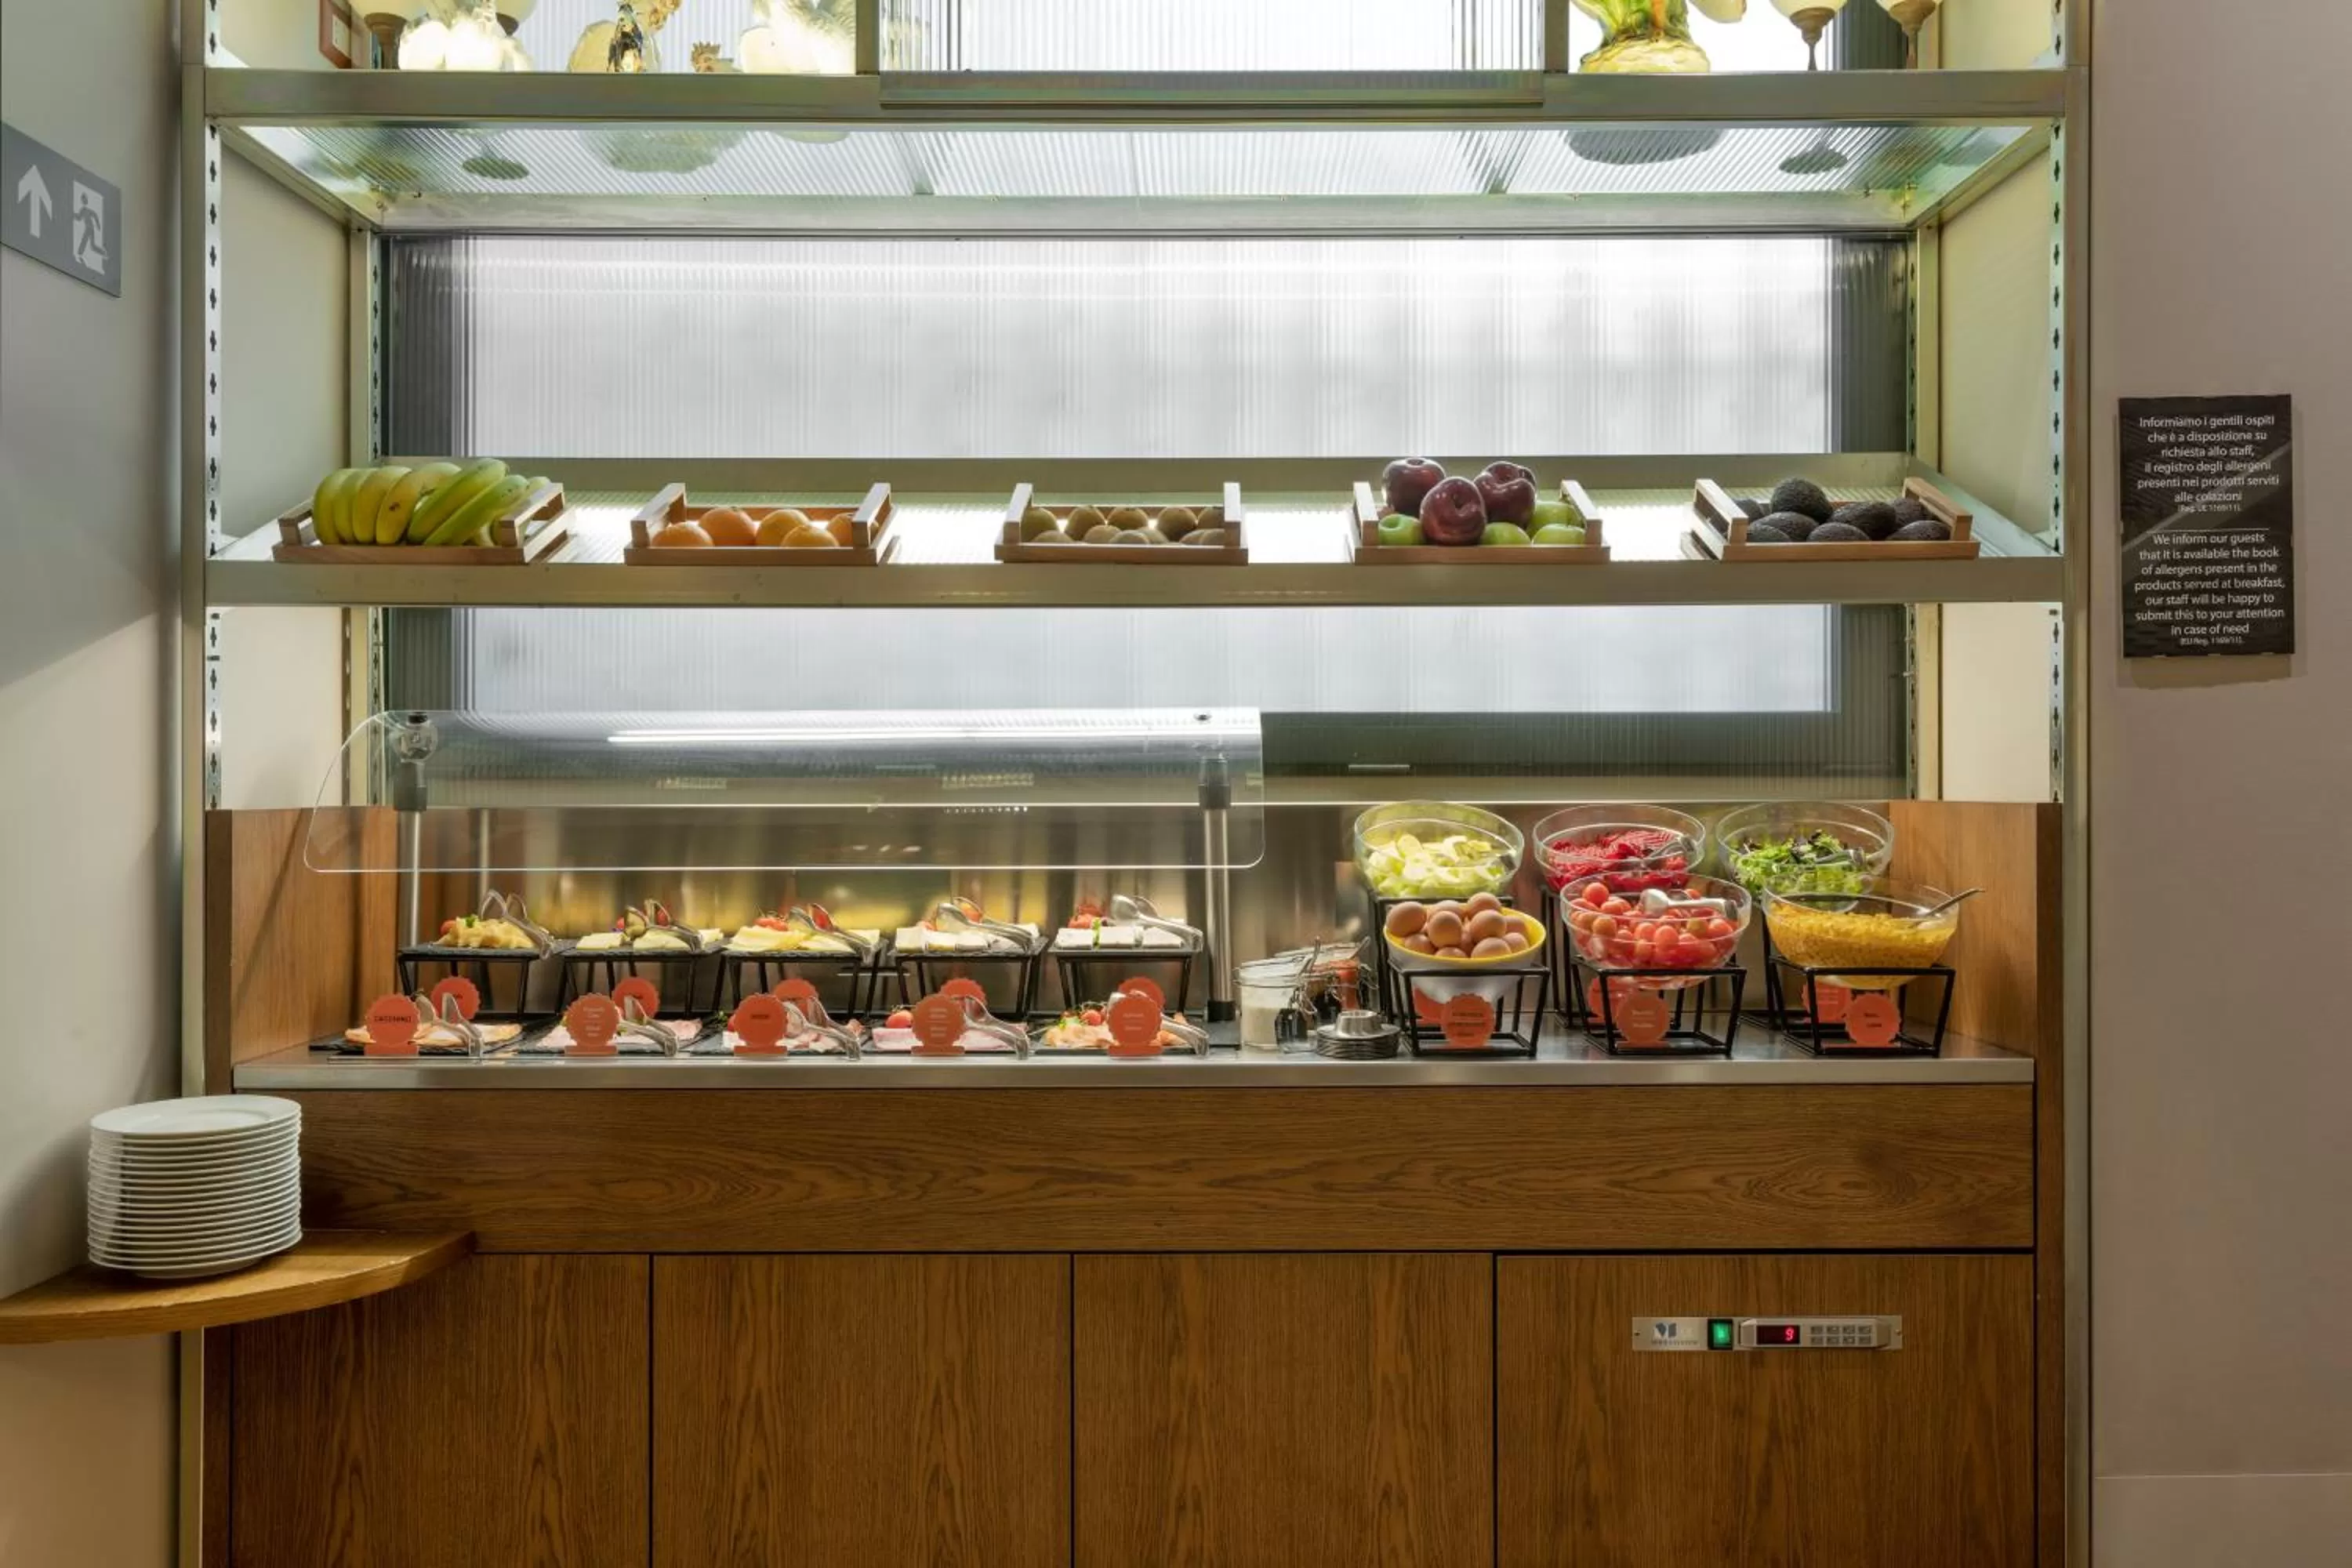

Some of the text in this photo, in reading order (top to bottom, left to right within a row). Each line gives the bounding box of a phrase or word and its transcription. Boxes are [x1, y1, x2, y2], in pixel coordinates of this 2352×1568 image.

[2140, 416, 2201, 427] Informiamo
[2210, 416, 2243, 428] gentili
[2245, 416, 2274, 426] ospiti
[2147, 433, 2168, 442] che
[2187, 431, 2252, 443] disposizione
[2161, 447, 2205, 457] richiesta
[2208, 446, 2227, 456] allo
[2154, 463, 2194, 474] registro
[2197, 461, 2223, 474] degli
[2224, 461, 2270, 472] allergeni
[2138, 475, 2279, 489] presenti nei prodotti serviti
[2175, 492, 2193, 502] alle
[2154, 535, 2170, 544] We
[2172, 534, 2207, 543] inform
[2230, 533, 2265, 546] guests
[2140, 546, 2278, 560] that it is available the book
[2141, 562, 2277, 577] of allergens present in the
[2135, 580, 2181, 593] products
[2183, 579, 2219, 590] served
[2145, 593, 2274, 607] our staff will be happy to
[2136, 611, 2172, 620] submit
[2175, 610, 2194, 619] this
[2210, 610, 2233, 621] your
[2235, 608, 2284, 618] attention
[2172, 624, 2249, 635] in case of need
[1785, 1327, 1795, 1341] 9
